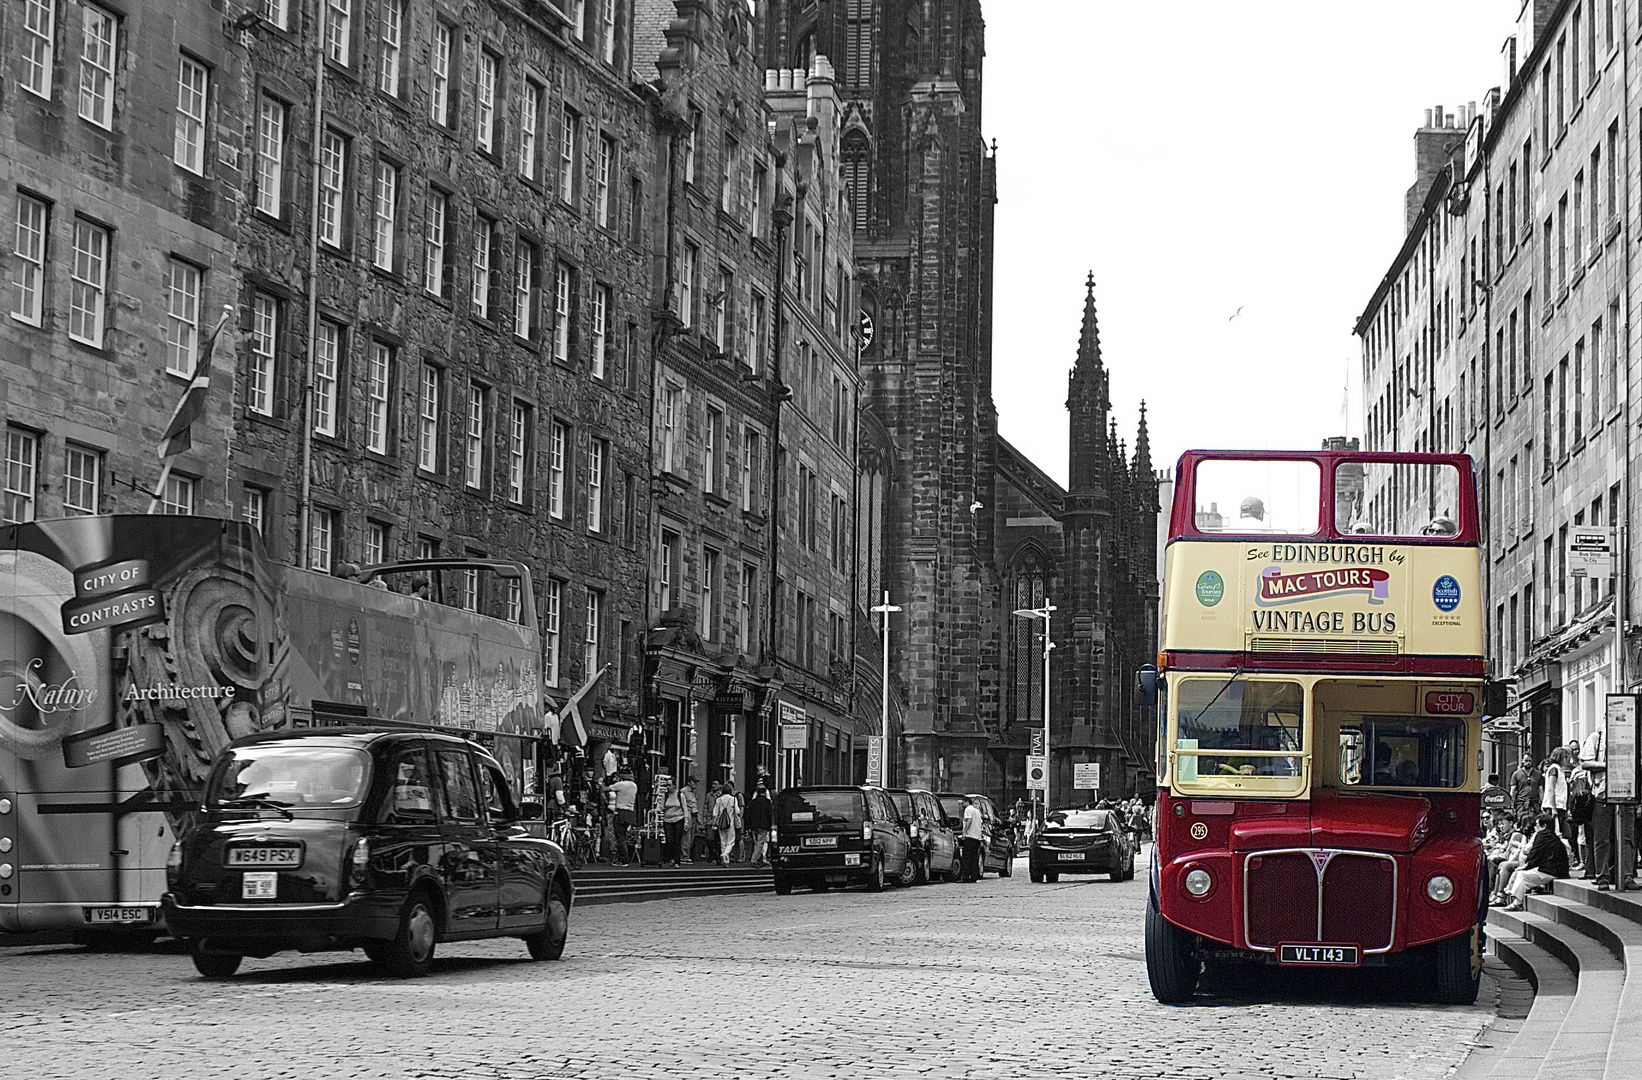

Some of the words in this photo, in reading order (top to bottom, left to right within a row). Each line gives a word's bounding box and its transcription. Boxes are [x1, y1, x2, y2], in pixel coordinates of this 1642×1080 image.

[1247, 548, 1270, 561] See
[1272, 545, 1384, 564] EDINBURGH
[1388, 549, 1406, 565] by
[84, 573, 116, 591] CITY
[120, 567, 139, 581] OF
[1268, 576, 1307, 595] MAC
[1312, 570, 1371, 589] TOURS
[70, 596, 156, 627] CONTRASTS
[1252, 610, 1345, 633] VINTAGE
[1352, 612, 1397, 634] BUS
[3, 658, 98, 725] Nature
[125, 682, 236, 700] Architecture
[1438, 694, 1462, 703] CITY
[1435, 703, 1465, 712] TOUR
[1032, 730, 1042, 756] TIVAL
[870, 738, 880, 777] TICKETS
[1194, 826, 1205, 836] 295
[270, 849, 295, 862] PSX
[98, 910, 119, 920] V514
[122, 910, 141, 919] ESC
[1296, 948, 1320, 960] VLT
[1323, 949, 1344, 961] 143
